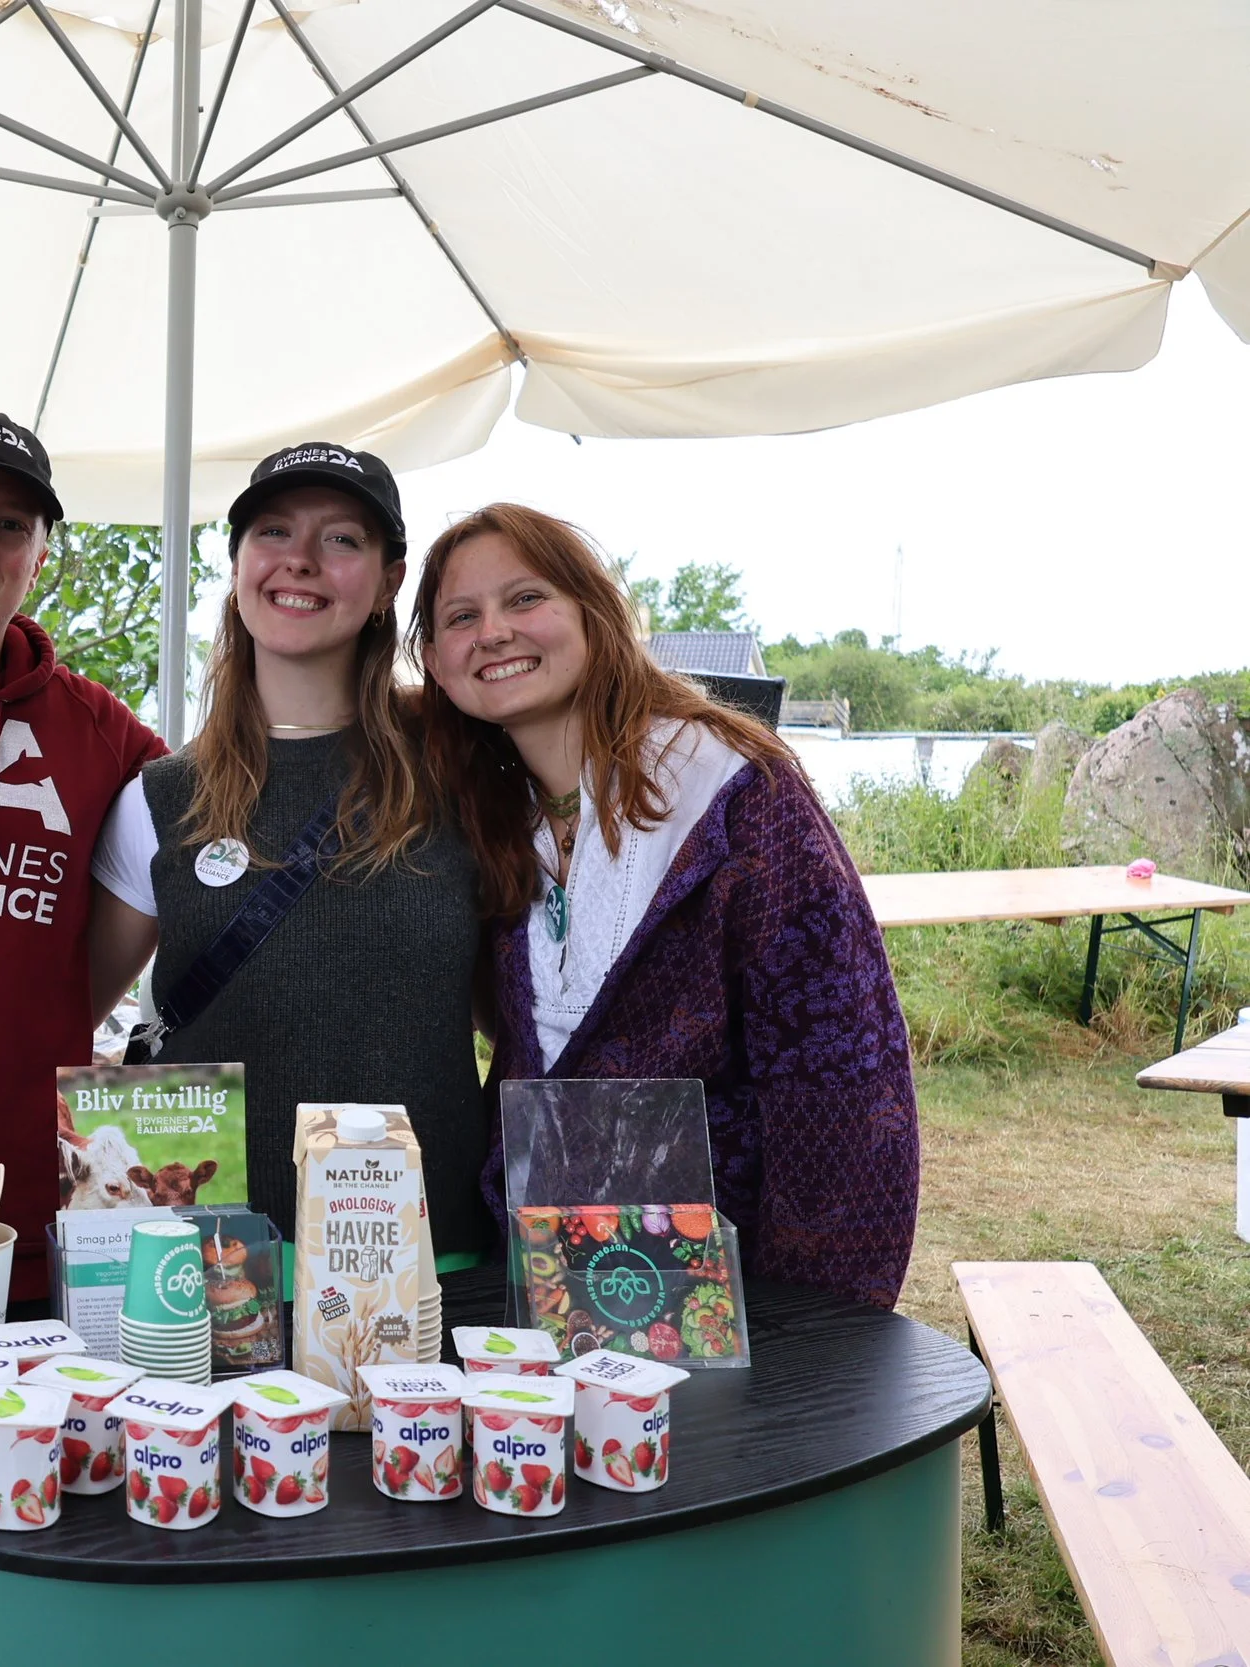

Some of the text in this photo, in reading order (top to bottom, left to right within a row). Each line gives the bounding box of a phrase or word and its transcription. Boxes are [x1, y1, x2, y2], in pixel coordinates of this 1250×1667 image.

[270, 456, 328, 472] ALLIANCE
[275, 449, 328, 466] DYRENES
[197, 866, 230, 881] ALLIANCE
[76, 1085, 228, 1115] Bliv frivillig
[143, 1116, 188, 1125] DYRENES
[143, 1125, 188, 1134] ALLIANCE
[329, 1197, 396, 1215] ØKOLOGISK
[76, 1236, 105, 1245] Smag
[108, 1233, 122, 1244] på
[326, 1220, 399, 1245] HAVRE
[318, 1293, 347, 1312] Dansk
[323, 1305, 350, 1322] havre
[125, 1395, 204, 1416] alpro
[235, 1424, 270, 1452] alpro
[399, 1421, 450, 1446] alpro
[290, 1433, 327, 1456] alpro
[493, 1435, 546, 1460] alpro
[134, 1445, 182, 1470] alpro
